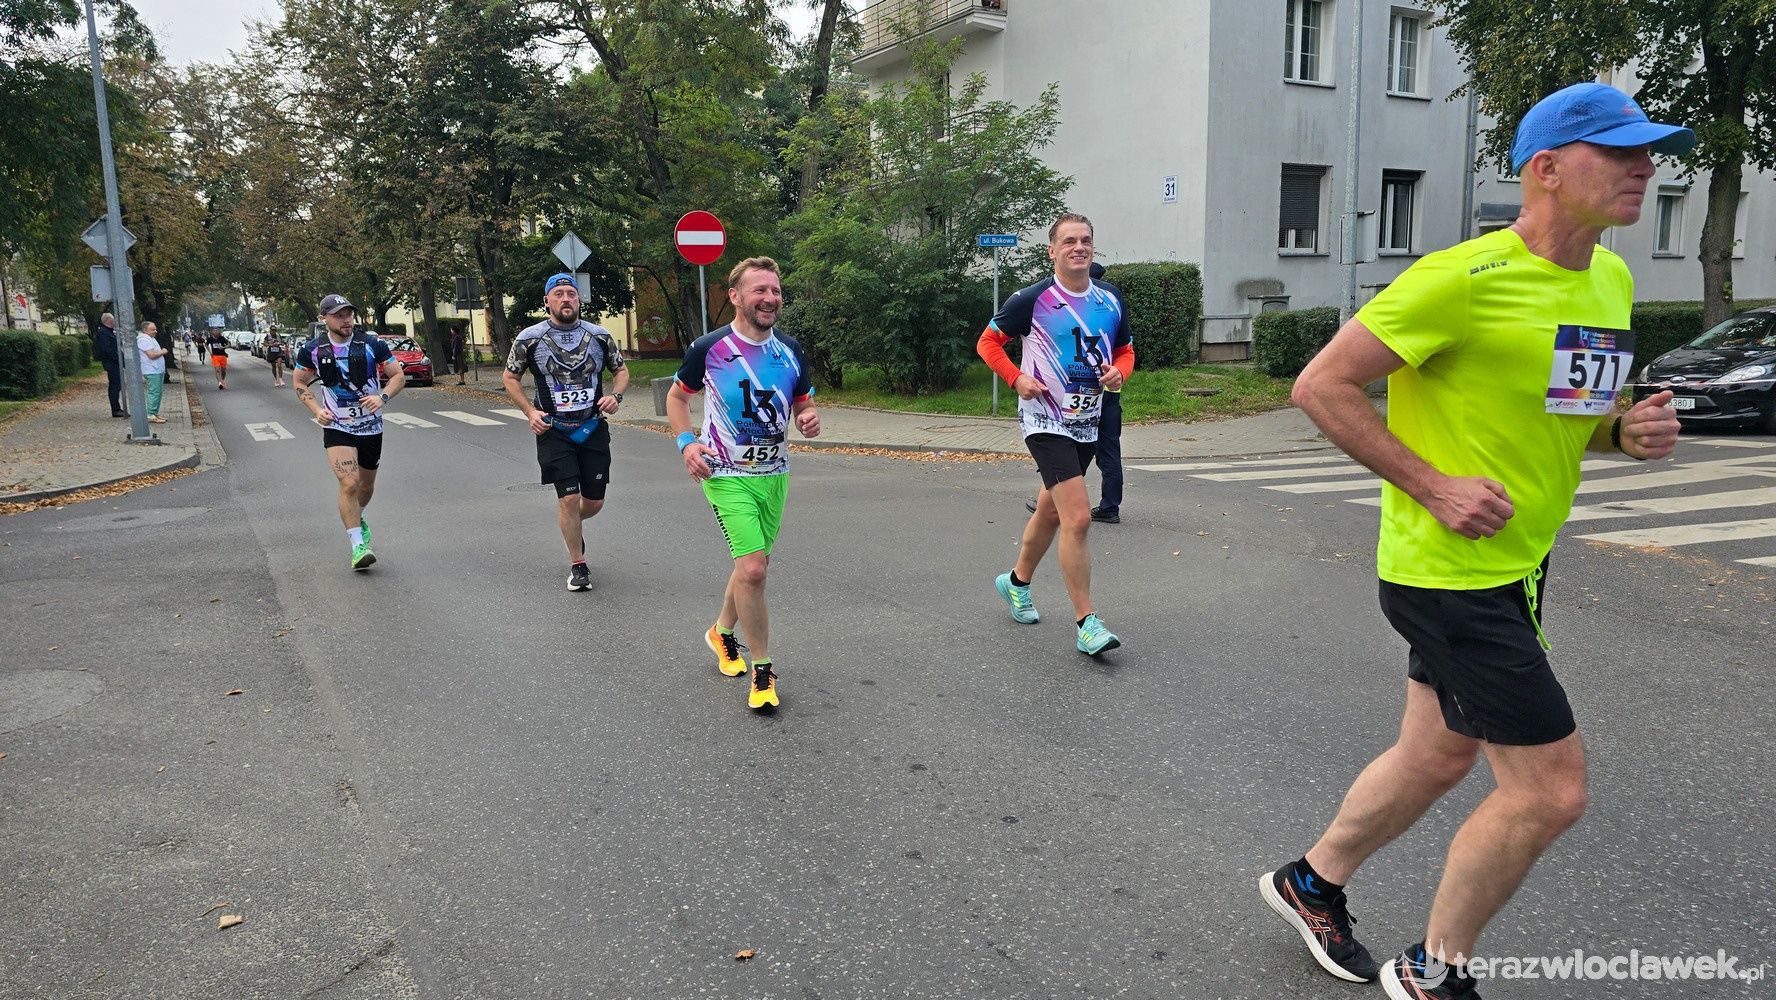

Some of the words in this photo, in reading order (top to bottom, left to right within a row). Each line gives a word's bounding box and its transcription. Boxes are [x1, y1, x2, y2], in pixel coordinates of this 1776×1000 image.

[1165, 183, 1175, 196] 31
[1071, 326, 1104, 368] 13
[1568, 352, 1620, 390] 571
[561, 390, 589, 403] 523
[738, 379, 778, 425] 13
[1069, 395, 1099, 410] 354
[742, 446, 779, 461] 452
